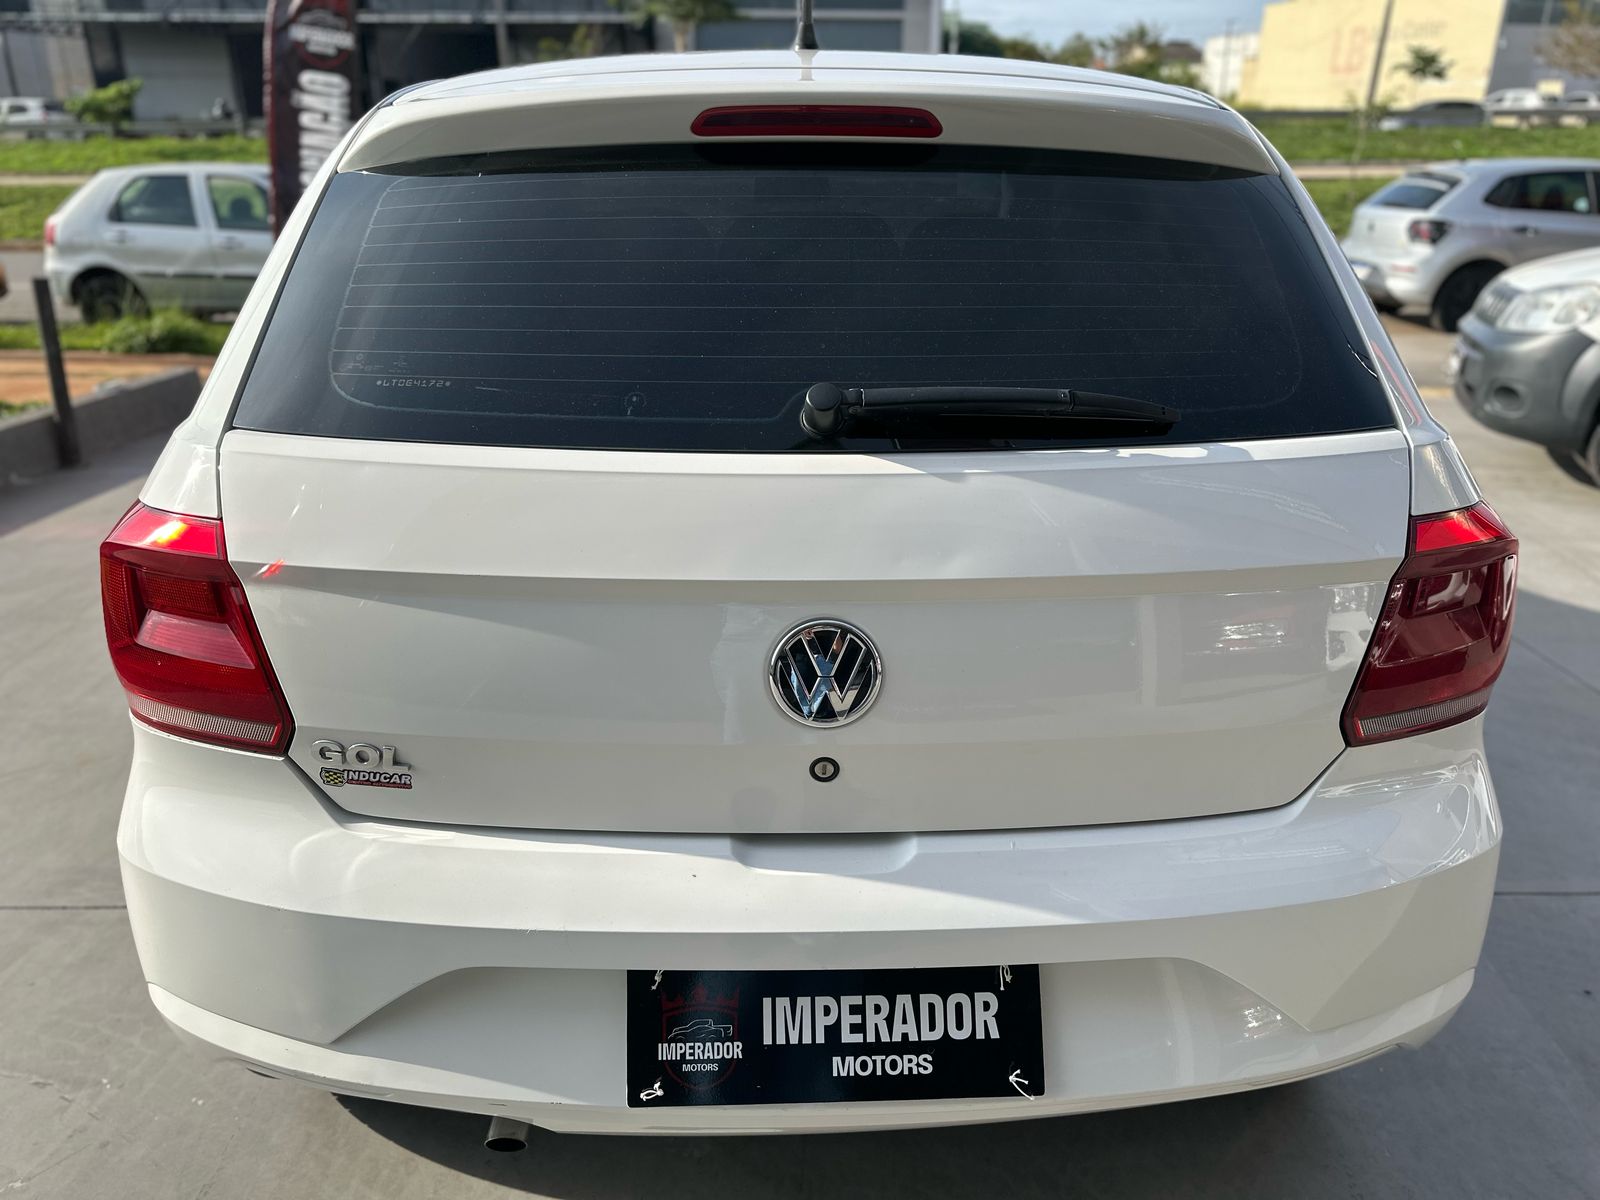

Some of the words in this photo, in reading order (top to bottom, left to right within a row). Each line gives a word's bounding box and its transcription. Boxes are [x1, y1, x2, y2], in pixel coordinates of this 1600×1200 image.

[311, 739, 411, 771] GOL
[343, 770, 411, 785] INDUCAR
[762, 992, 1000, 1045] IMPERADOR
[658, 1041, 743, 1060] IMPERADOR
[682, 1063, 719, 1072] MOTORS
[832, 1054, 934, 1077] MOTORS
